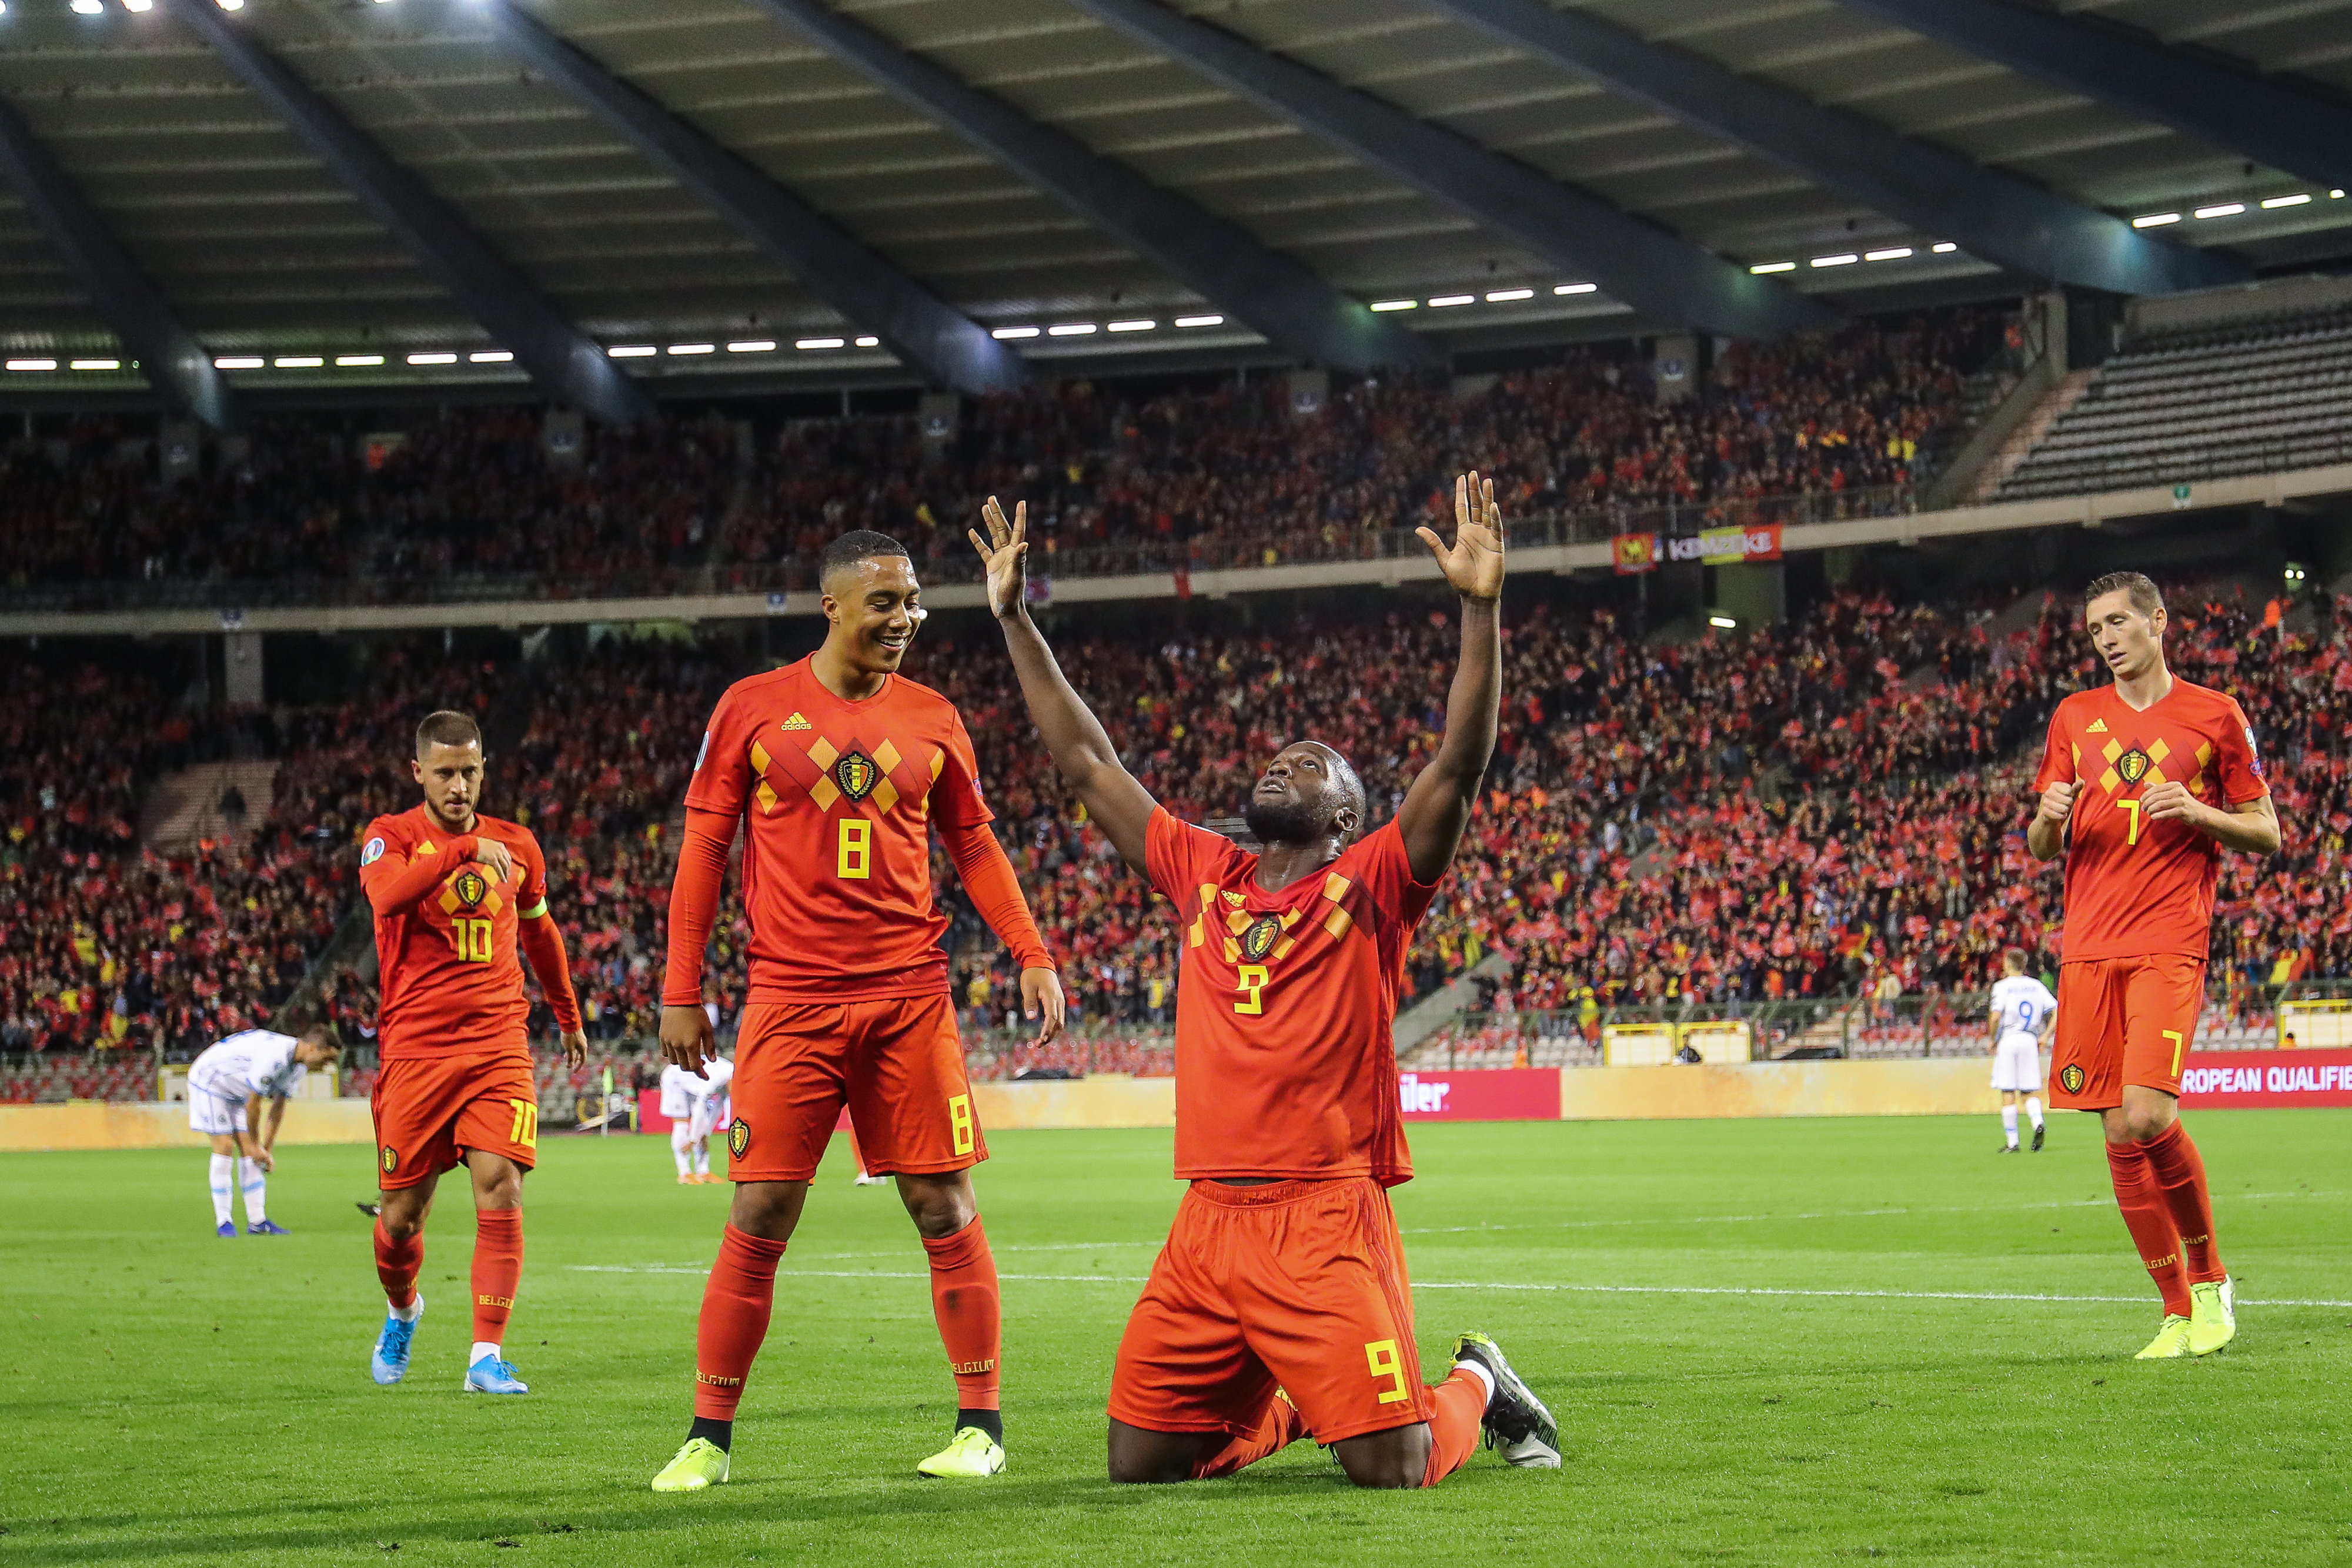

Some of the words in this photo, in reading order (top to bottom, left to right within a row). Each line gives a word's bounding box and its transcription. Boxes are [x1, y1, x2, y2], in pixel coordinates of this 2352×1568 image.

[781, 723, 812, 731] adidas
[2116, 799, 2140, 845] 7
[837, 818, 871, 879] 8
[452, 918, 493, 962] 10
[1234, 965, 1269, 1015] 9
[2019, 1001, 2033, 1031] 9
[2161, 1029, 2184, 1077] 7
[510, 1098, 538, 1149] 10
[948, 1094, 974, 1156] 8
[952, 1359, 994, 1373] ELGIUM
[1364, 1339, 1408, 1404] 9
